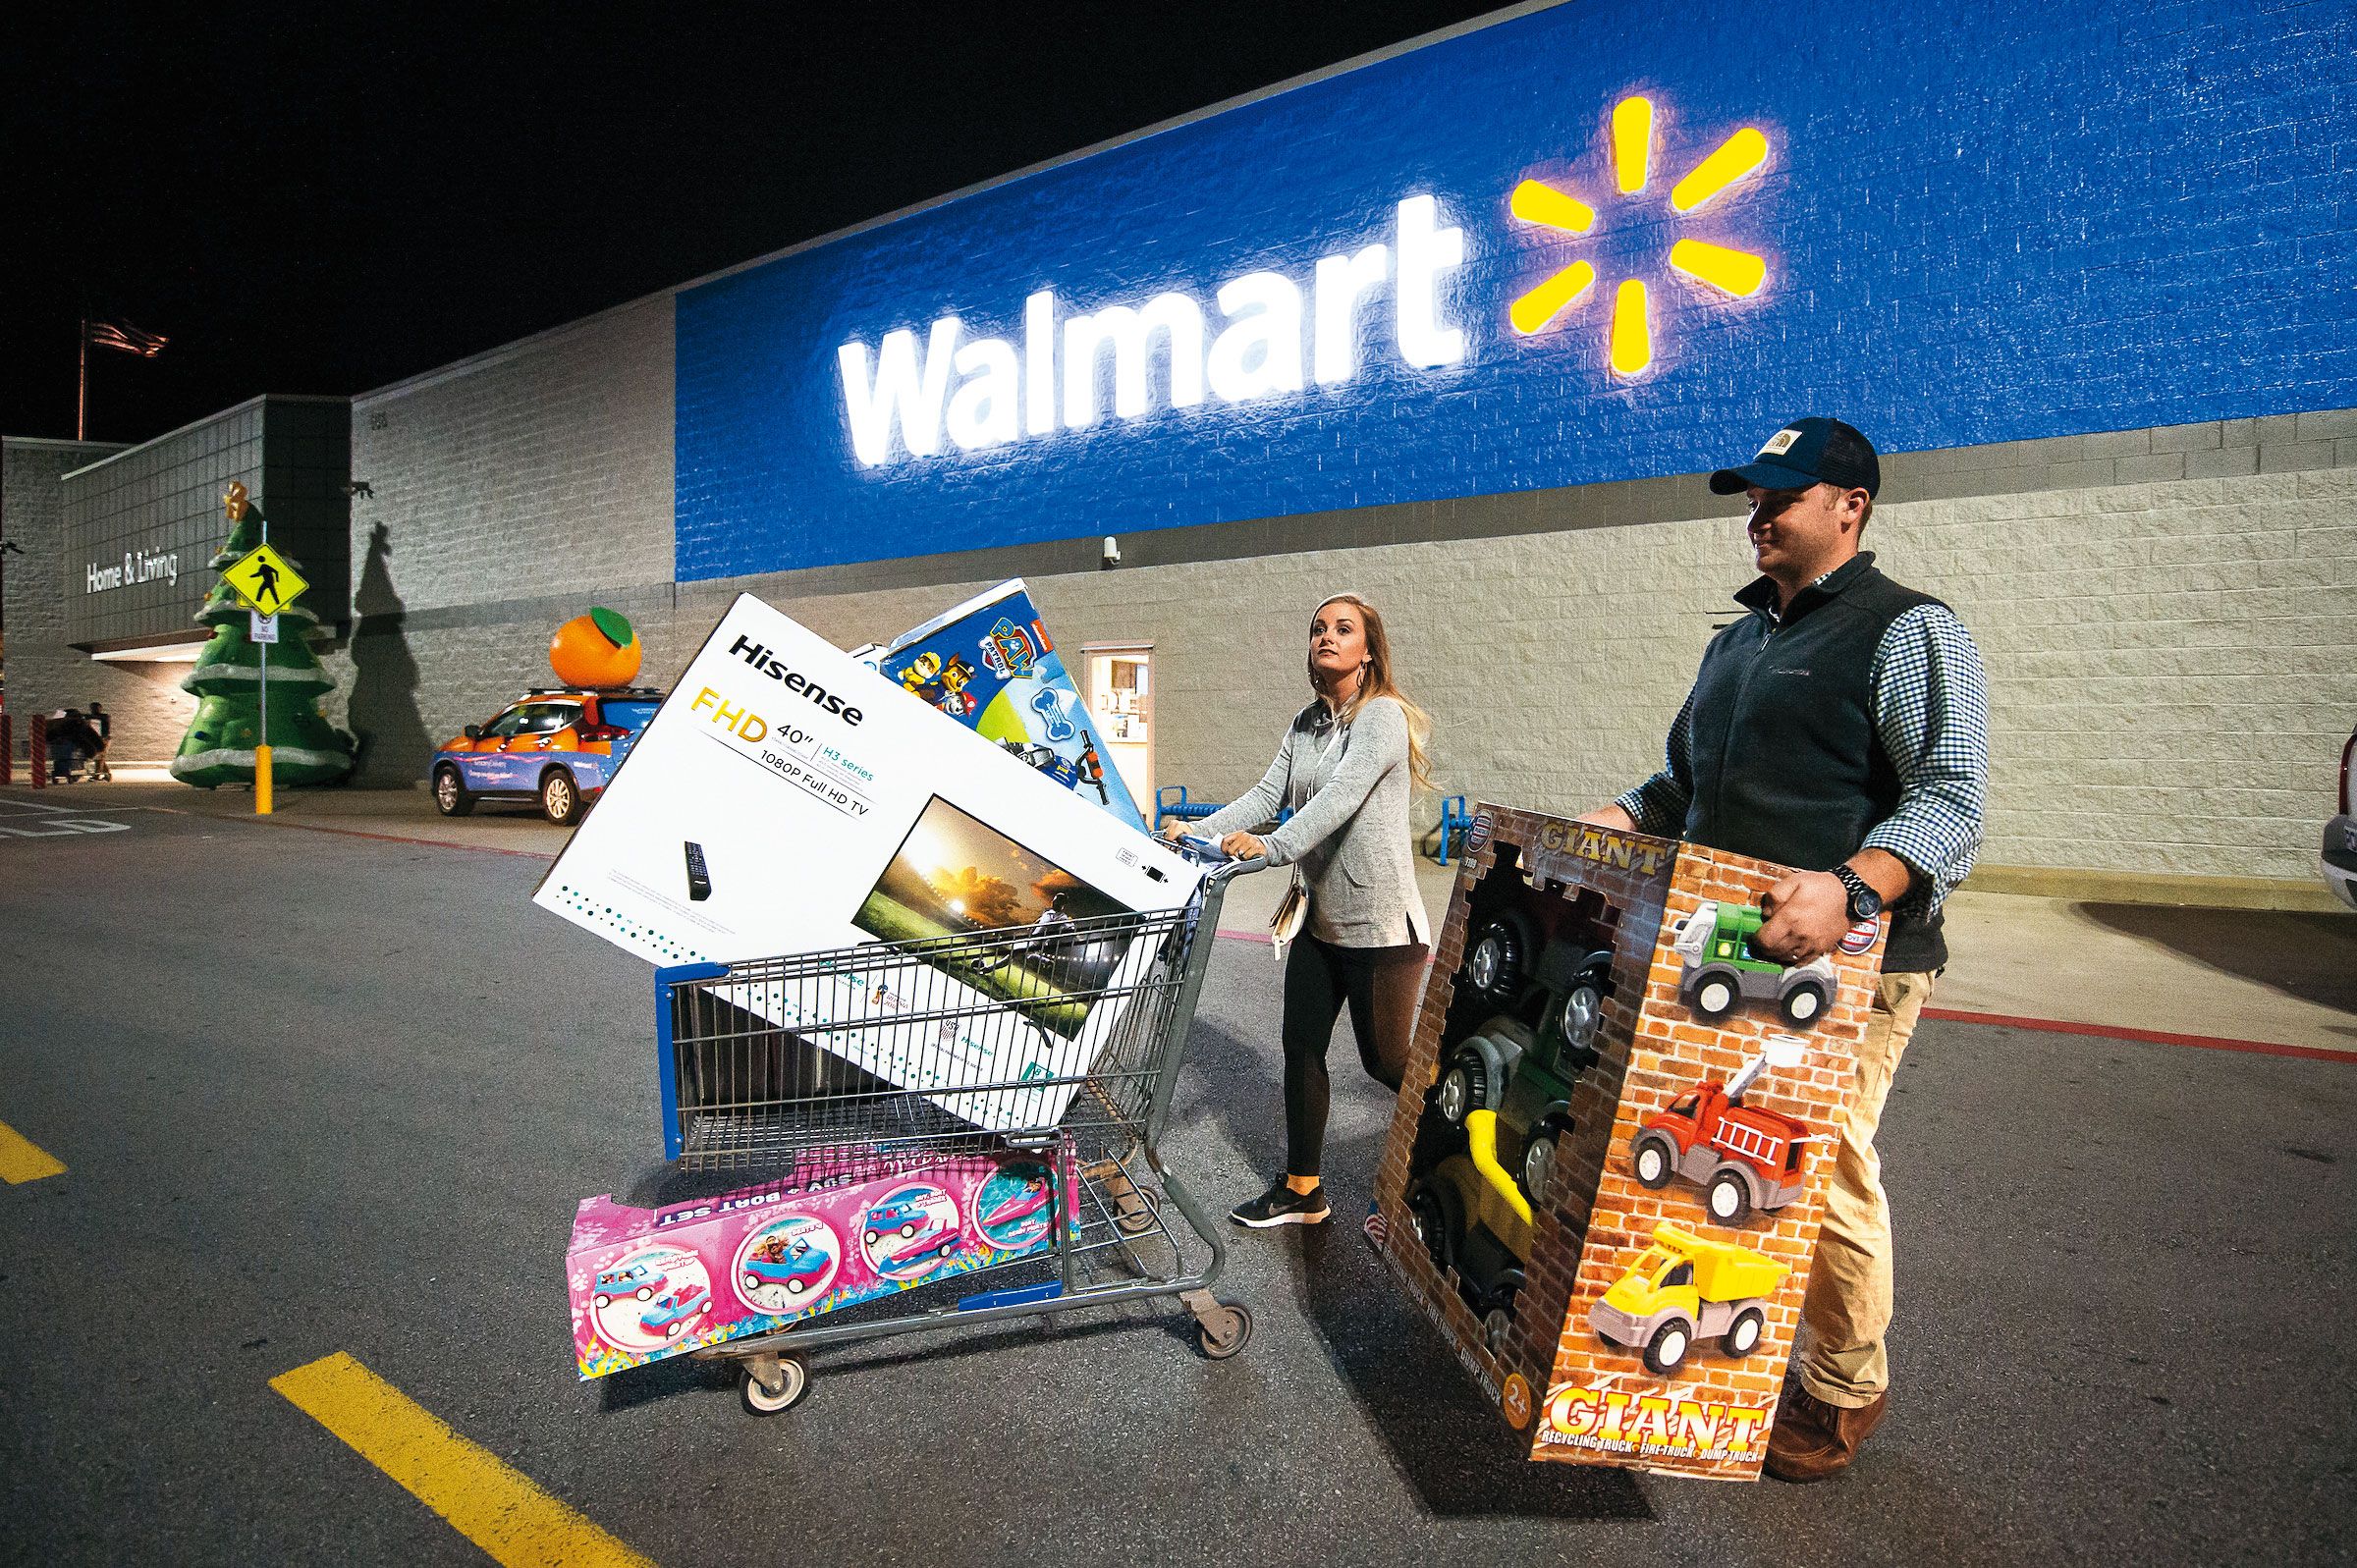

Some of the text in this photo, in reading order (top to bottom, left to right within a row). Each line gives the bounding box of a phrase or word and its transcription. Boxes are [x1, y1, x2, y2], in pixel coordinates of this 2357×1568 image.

[837, 193, 1464, 466] Walmart
[86, 546, 178, 594] Home & Living
[984, 640, 1007, 676] PATROL
[989, 617, 1035, 679] PAW
[729, 634, 863, 727] Hisense
[690, 686, 768, 743] FHD
[760, 749, 801, 777] 1080P
[801, 774, 828, 794] Full
[827, 787, 848, 806] HD
[850, 800, 869, 816] TV
[822, 746, 841, 762] H3
[841, 758, 875, 783] series
[1541, 823, 1667, 876] GIANT
[718, 1191, 782, 1214] BOAT
[806, 1173, 853, 1193] SUV
[658, 1207, 712, 1227] SET
[1460, 1347, 1480, 1376] DUMP
[1479, 1371, 1502, 1407] TRUCK
[1507, 1382, 1527, 1414] 2+
[1548, 1385, 1767, 1452] GIANT
[1541, 1430, 1598, 1450] RECYCLING
[1598, 1437, 1633, 1454] TRUCK
[1700, 1448, 1728, 1461] DUMP
[1727, 1451, 1759, 1463] TRUCK
